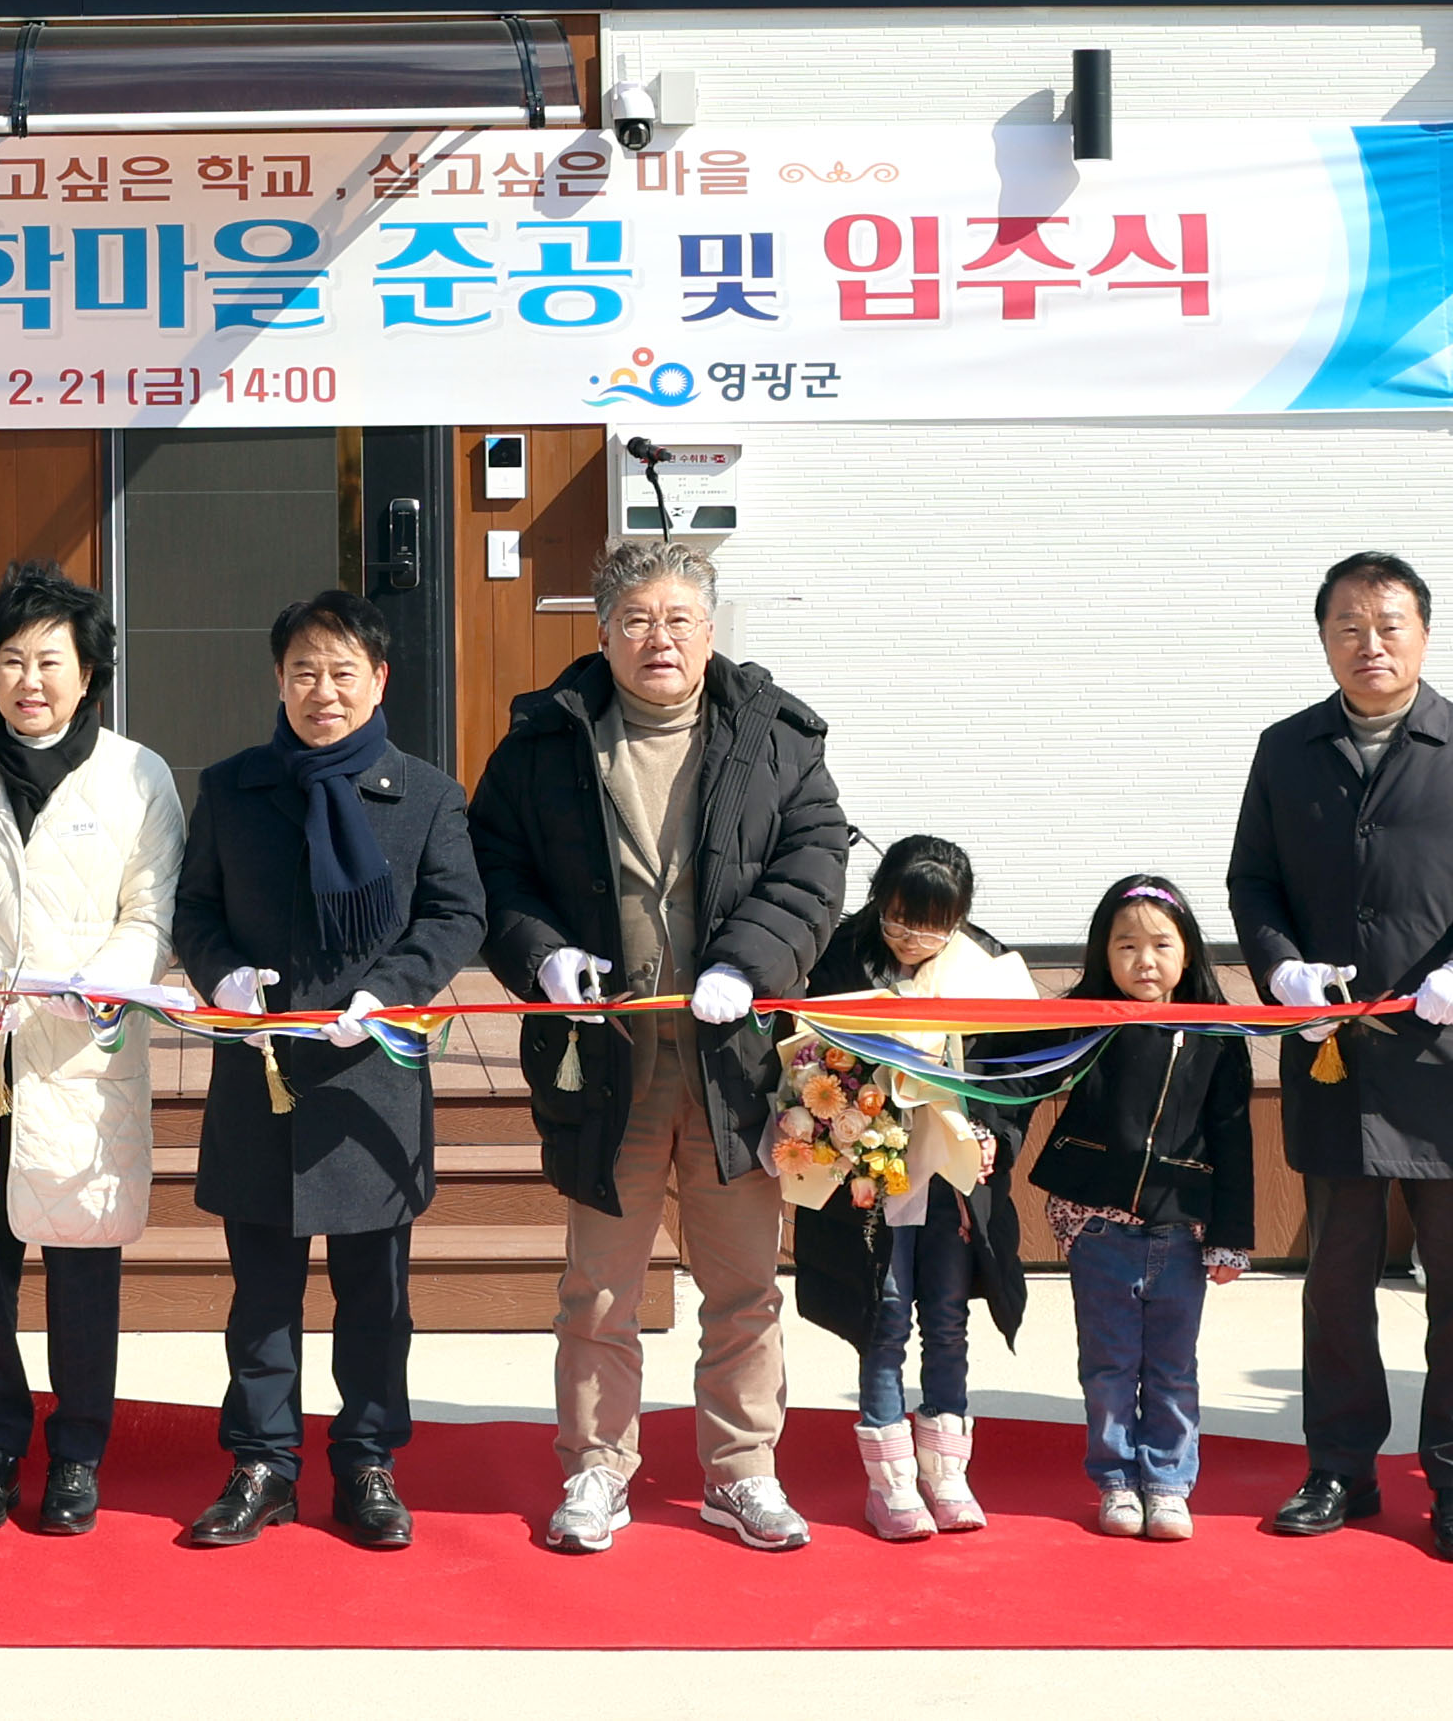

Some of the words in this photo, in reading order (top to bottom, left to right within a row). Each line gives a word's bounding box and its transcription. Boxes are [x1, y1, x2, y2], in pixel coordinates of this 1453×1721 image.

[367, 150, 607, 199] 살고싶은
[636, 149, 750, 196] 마을
[372, 220, 633, 330] 준공
[678, 232, 781, 323] 및
[824, 212, 1211, 321] 입주식
[8, 368, 44, 405] 2.
[59, 368, 106, 405] 21
[127, 366, 200, 406] (금)
[219, 366, 337, 403] 14:00
[707, 362, 842, 402] 영광군
